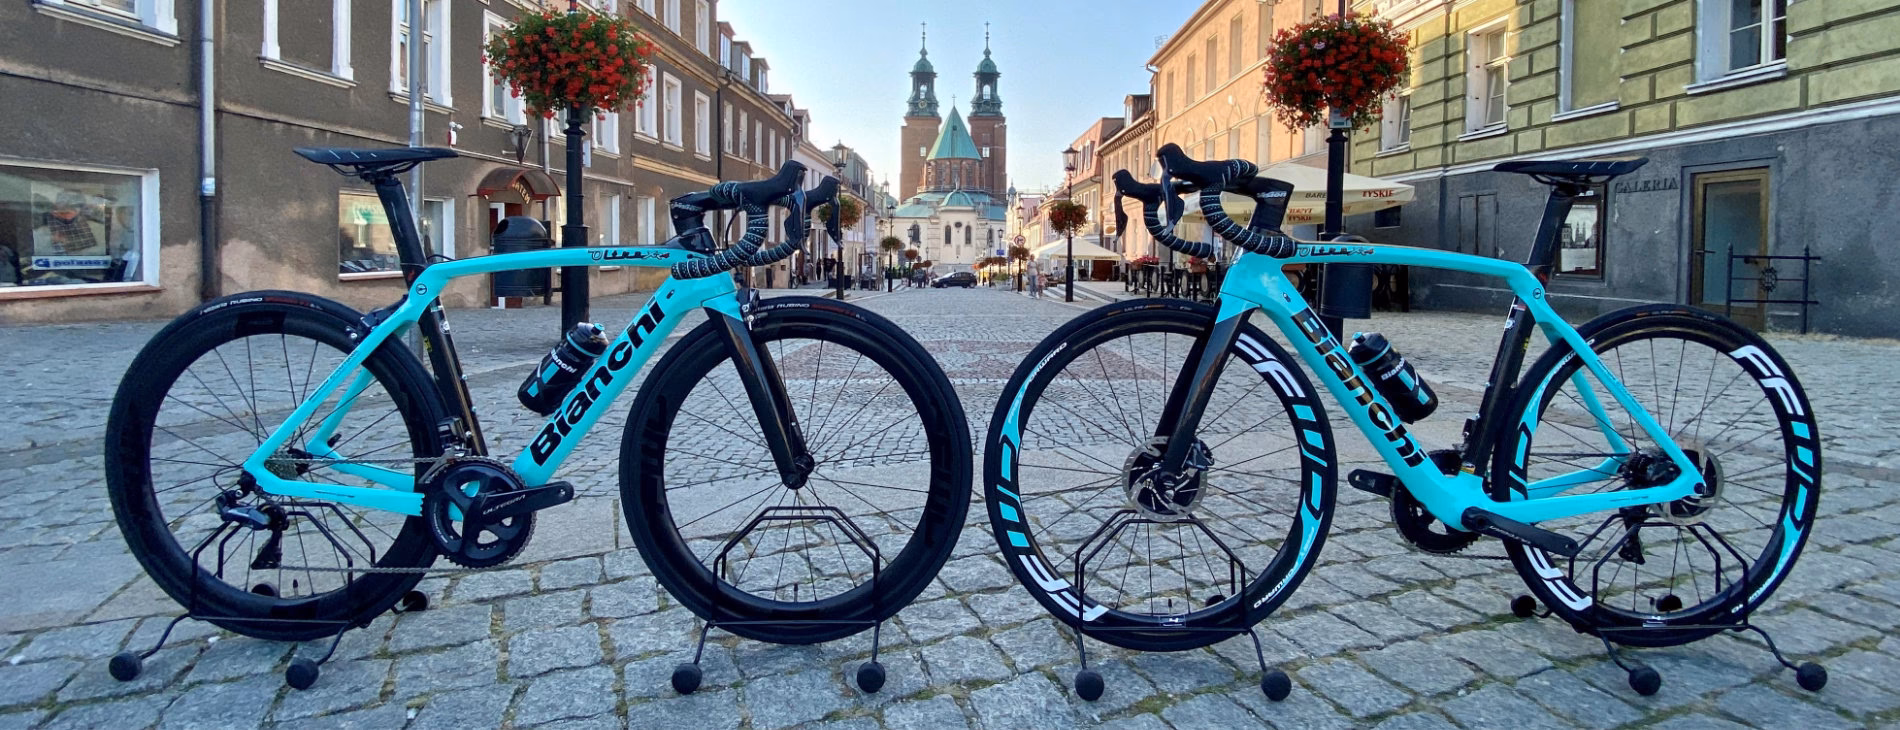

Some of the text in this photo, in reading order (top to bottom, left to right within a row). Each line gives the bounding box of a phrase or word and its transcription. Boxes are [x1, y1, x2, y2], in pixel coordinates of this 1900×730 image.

[1362, 189, 1394, 198] TYSKIE
[1614, 177, 1679, 193] GALERIA
[530, 296, 665, 467] Bianchi
[1290, 307, 1427, 468] Bianchi
